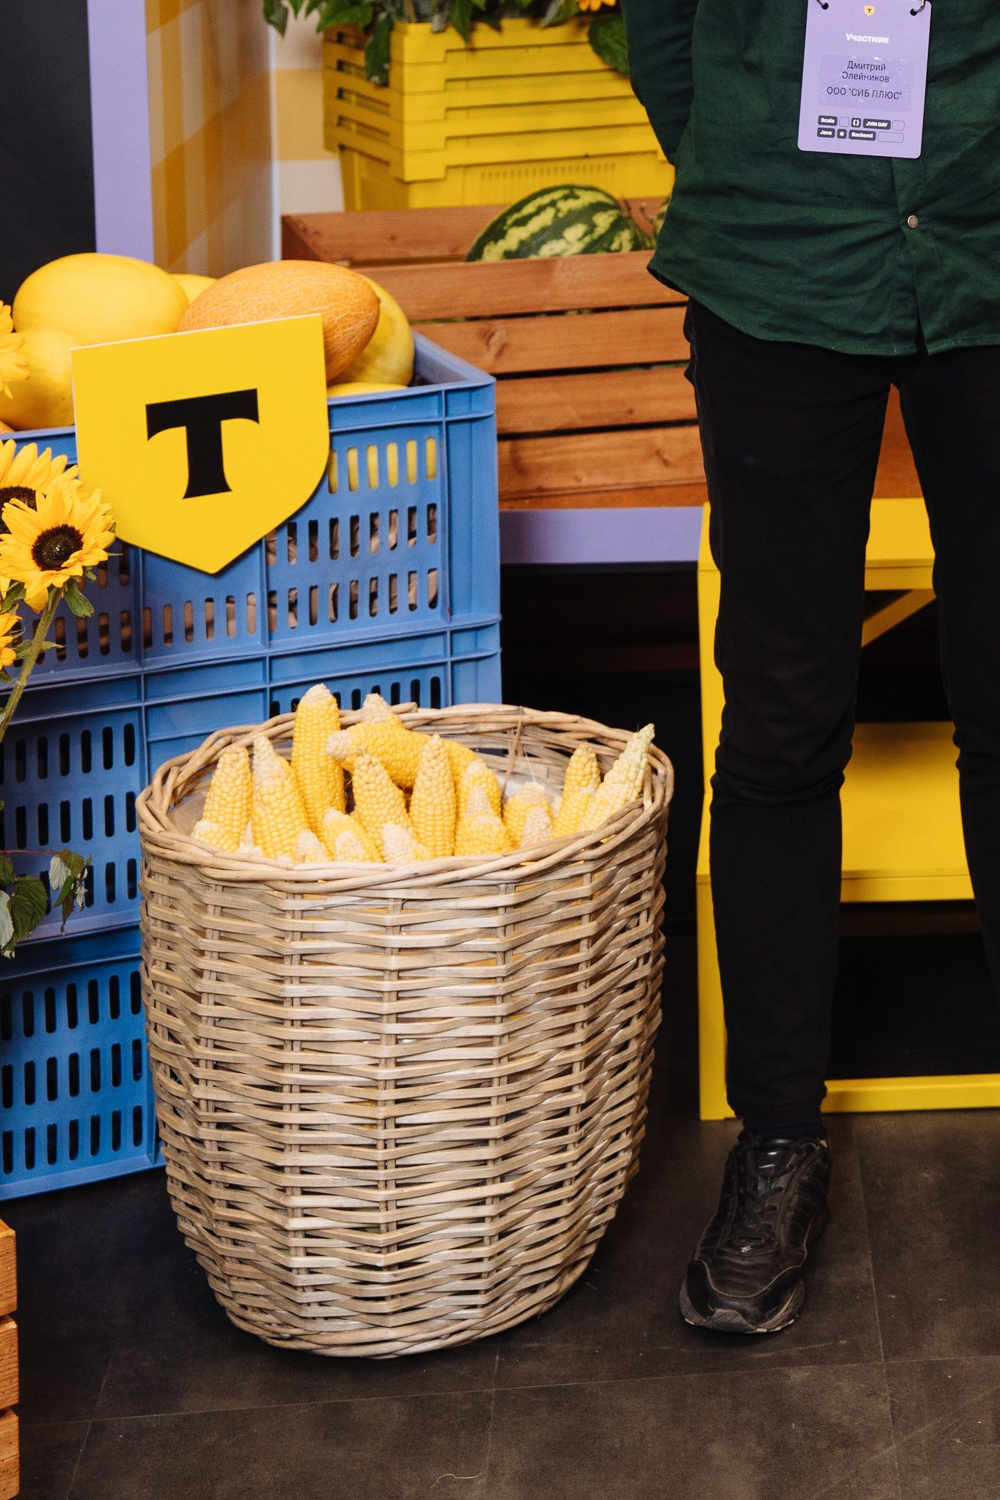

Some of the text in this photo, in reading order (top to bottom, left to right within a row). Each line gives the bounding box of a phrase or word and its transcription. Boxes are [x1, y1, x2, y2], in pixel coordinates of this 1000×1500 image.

[846, 33, 889, 43] Участник
[847, 60, 886, 71] Дмитрий
[842, 71, 890, 83] Олейников
[827, 86, 846, 95] ООО
